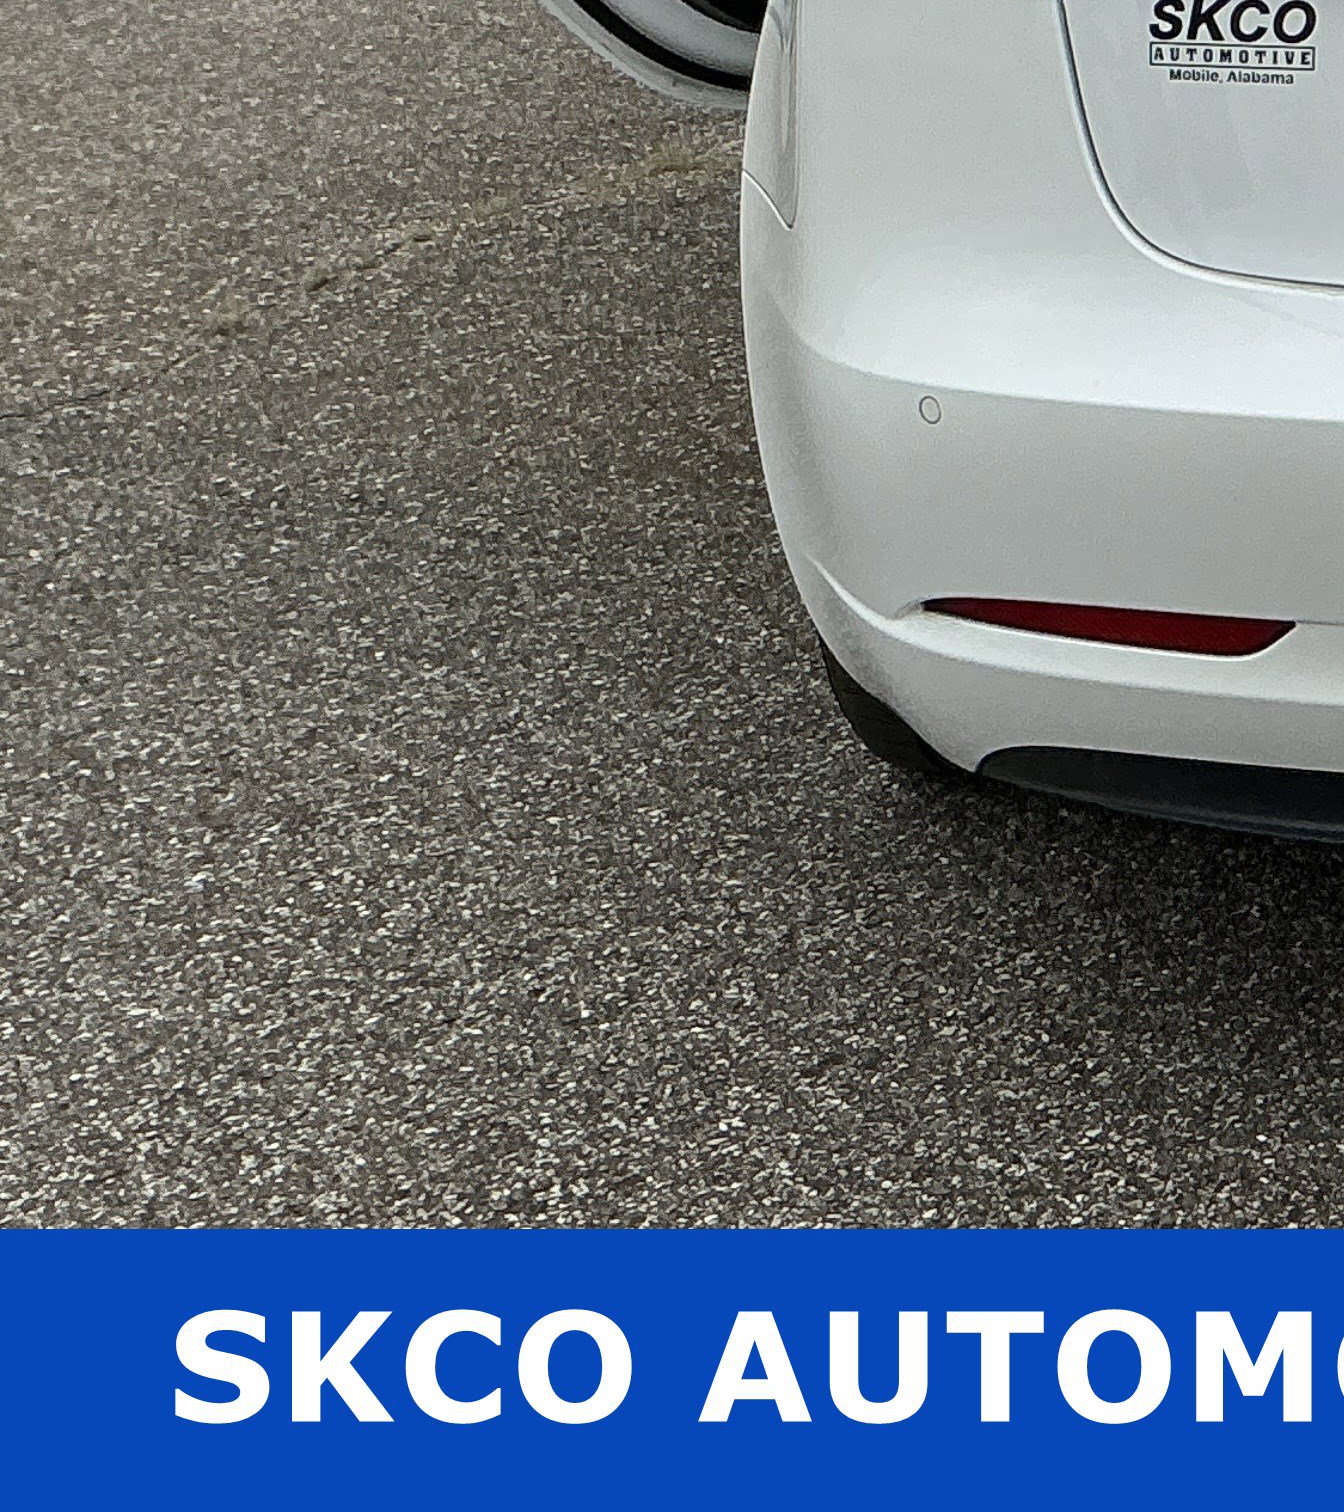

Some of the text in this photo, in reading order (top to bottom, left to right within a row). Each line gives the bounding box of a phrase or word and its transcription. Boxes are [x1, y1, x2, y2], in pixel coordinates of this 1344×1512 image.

[1153, 46, 1311, 65] AUTOMOTIVE
[1169, 68, 1294, 84] Mobile, Alabama
